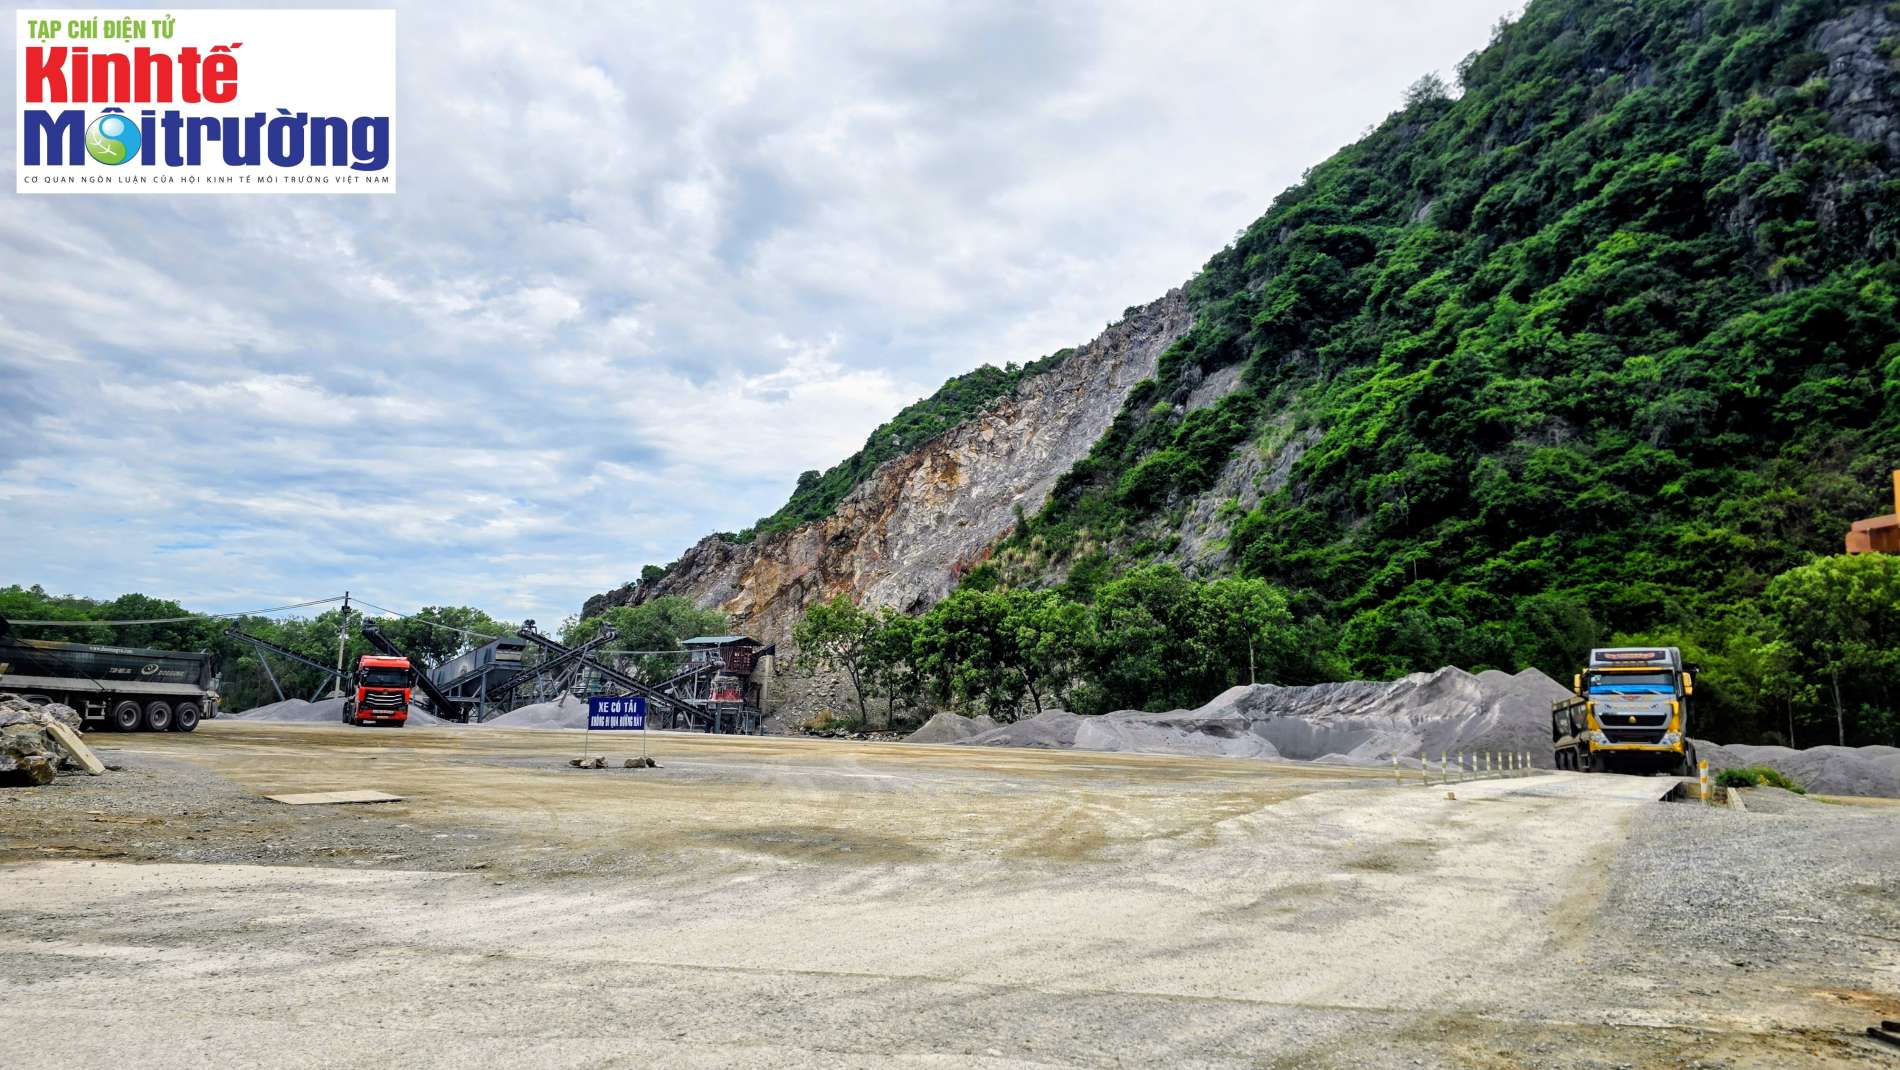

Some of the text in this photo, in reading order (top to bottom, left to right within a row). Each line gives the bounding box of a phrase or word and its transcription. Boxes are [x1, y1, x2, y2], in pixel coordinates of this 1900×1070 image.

[598, 699, 637, 713] XE CÓ TẢI
